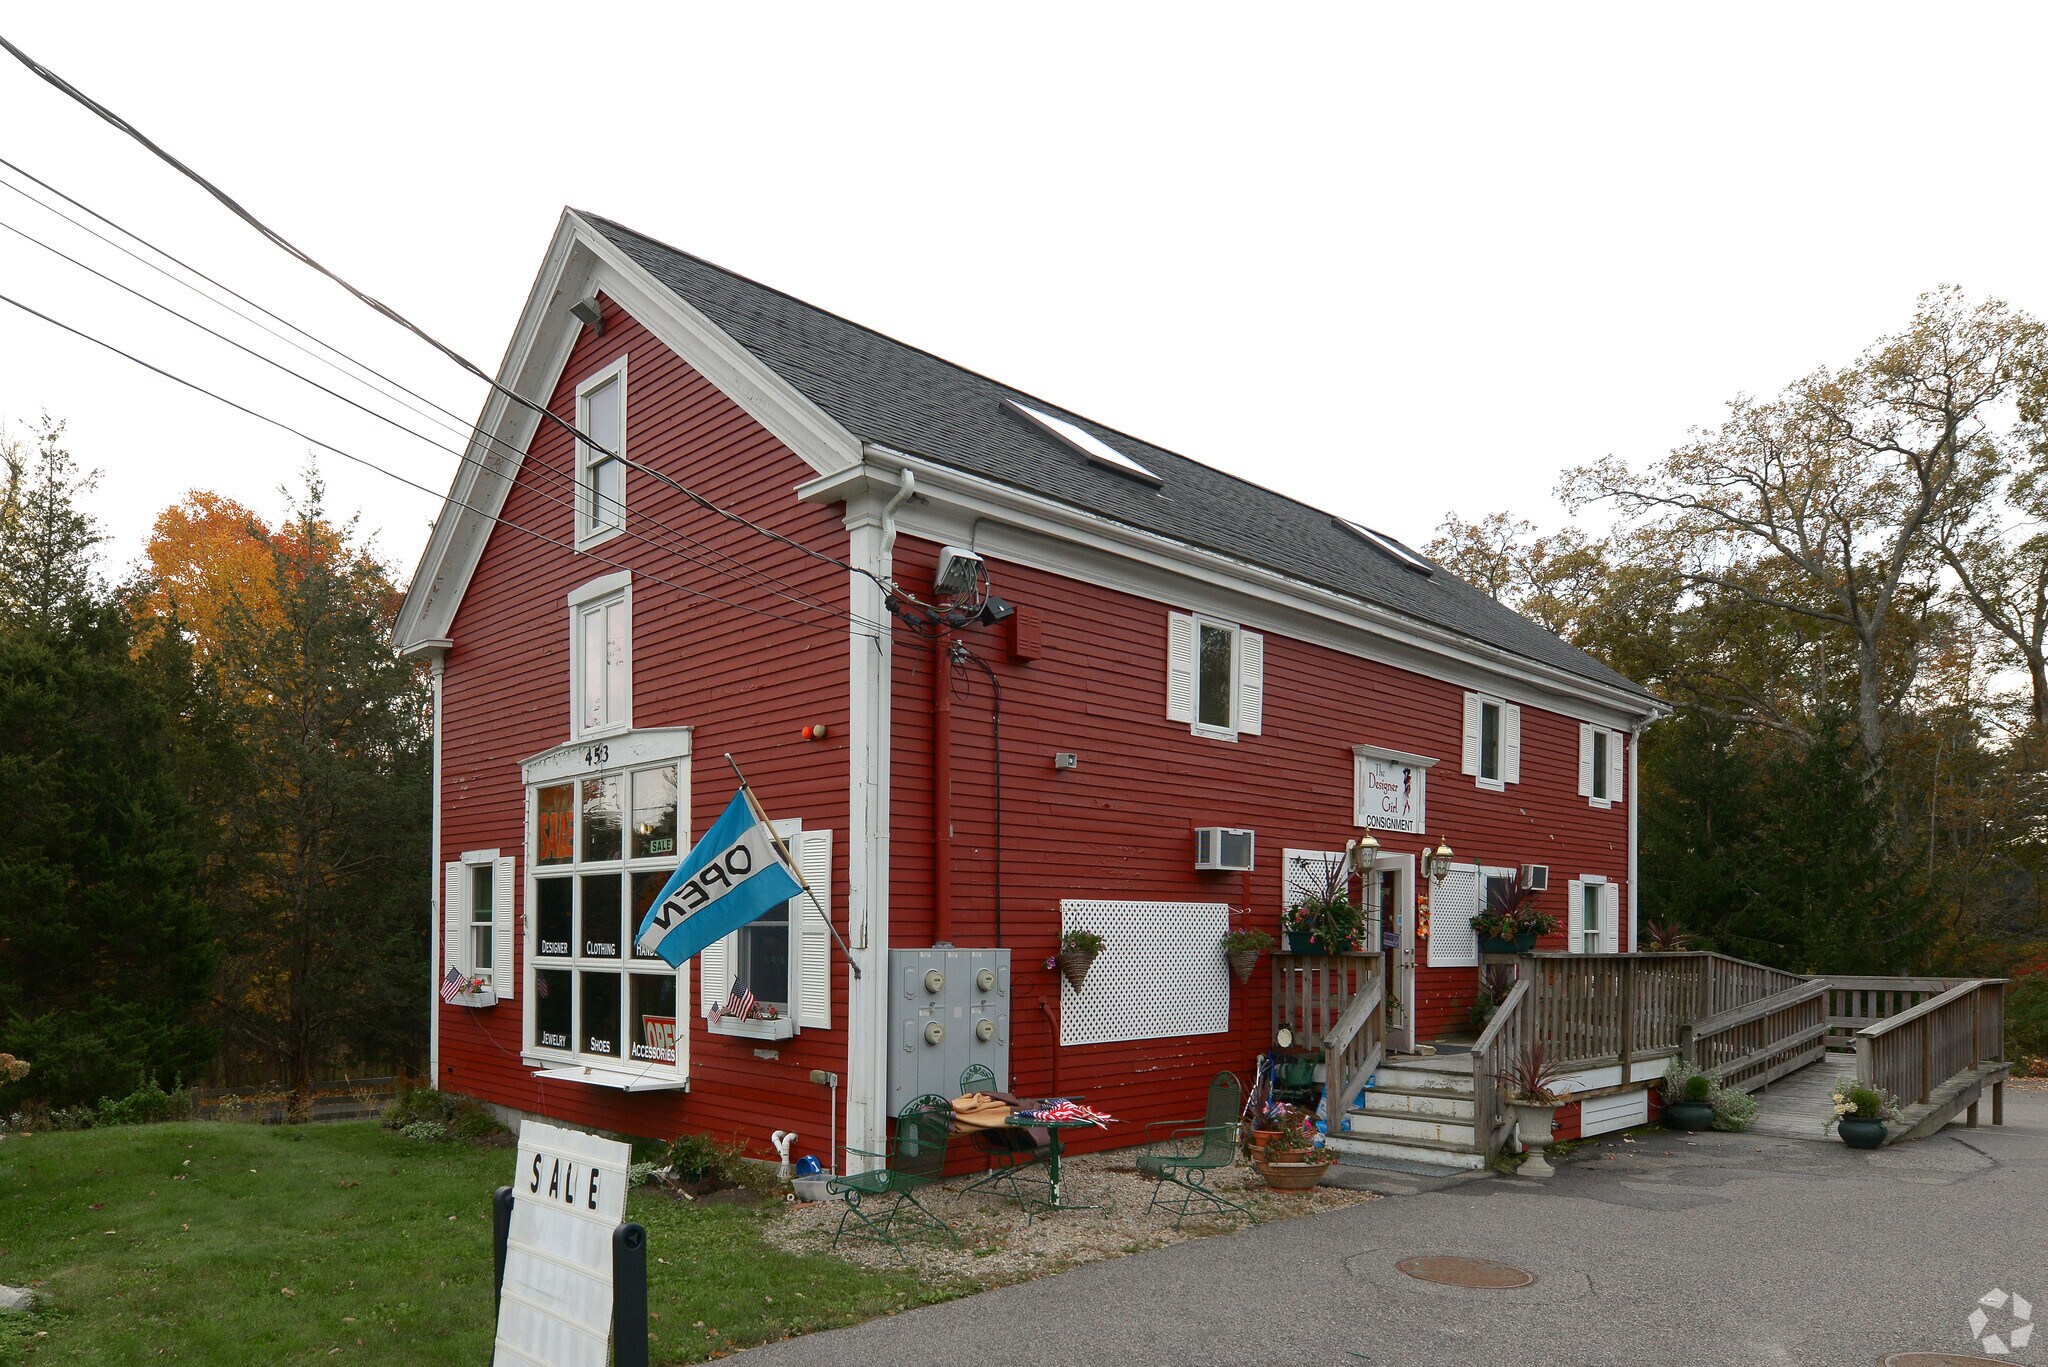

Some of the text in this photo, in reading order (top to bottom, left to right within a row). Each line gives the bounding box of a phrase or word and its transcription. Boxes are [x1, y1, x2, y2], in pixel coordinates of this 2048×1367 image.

[585, 744, 609, 766] 453
[1375, 763, 1386, 777] The
[1368, 772, 1399, 795] Designer
[1381, 796, 1398, 813] Girl
[1366, 815, 1413, 831] CONSIGNMENT
[652, 840, 671, 852] SALE
[541, 940, 568, 954] DESIGNER
[586, 941, 616, 956] CLOTHING
[541, 1031, 567, 1047] JEWELRY
[590, 1037, 611, 1053] SHOES
[647, 1021, 676, 1053] OPE
[632, 1042, 676, 1062] ACCESSORIES
[530, 1153, 600, 1209] SALE
